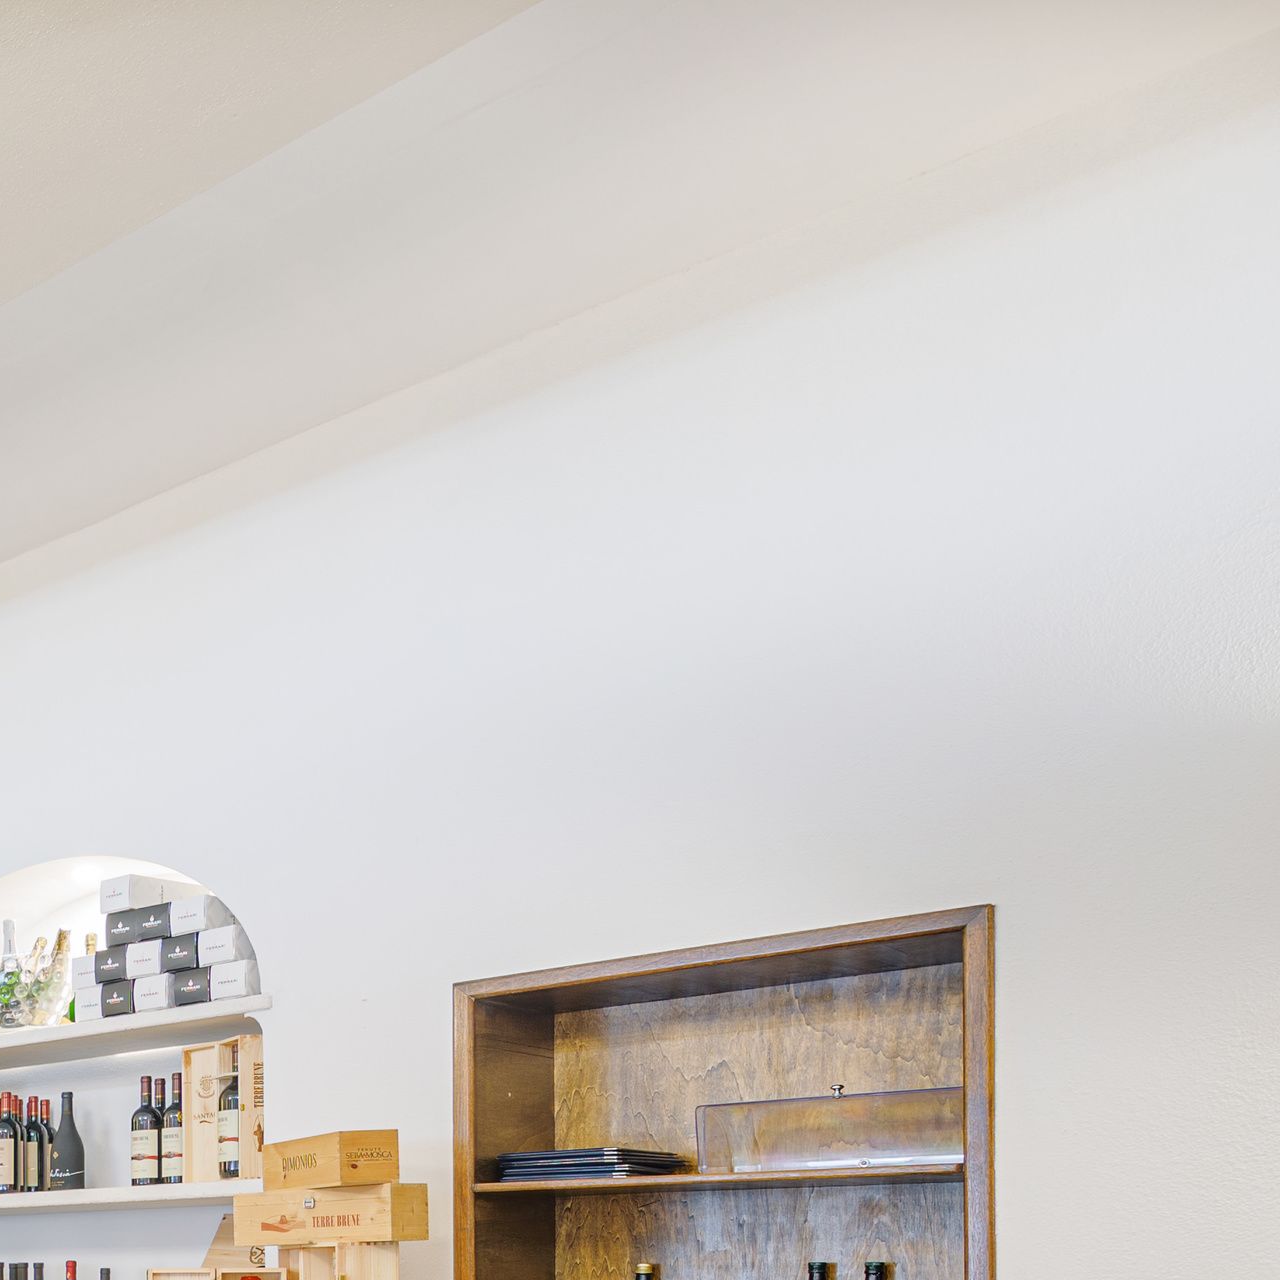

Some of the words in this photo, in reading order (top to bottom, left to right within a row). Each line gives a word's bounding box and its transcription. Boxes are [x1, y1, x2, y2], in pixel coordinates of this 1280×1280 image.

[282, 1153, 318, 1175] DIMONIOS
[312, 1215, 335, 1228] TERRE
[336, 1214, 360, 1227] BRUNE
